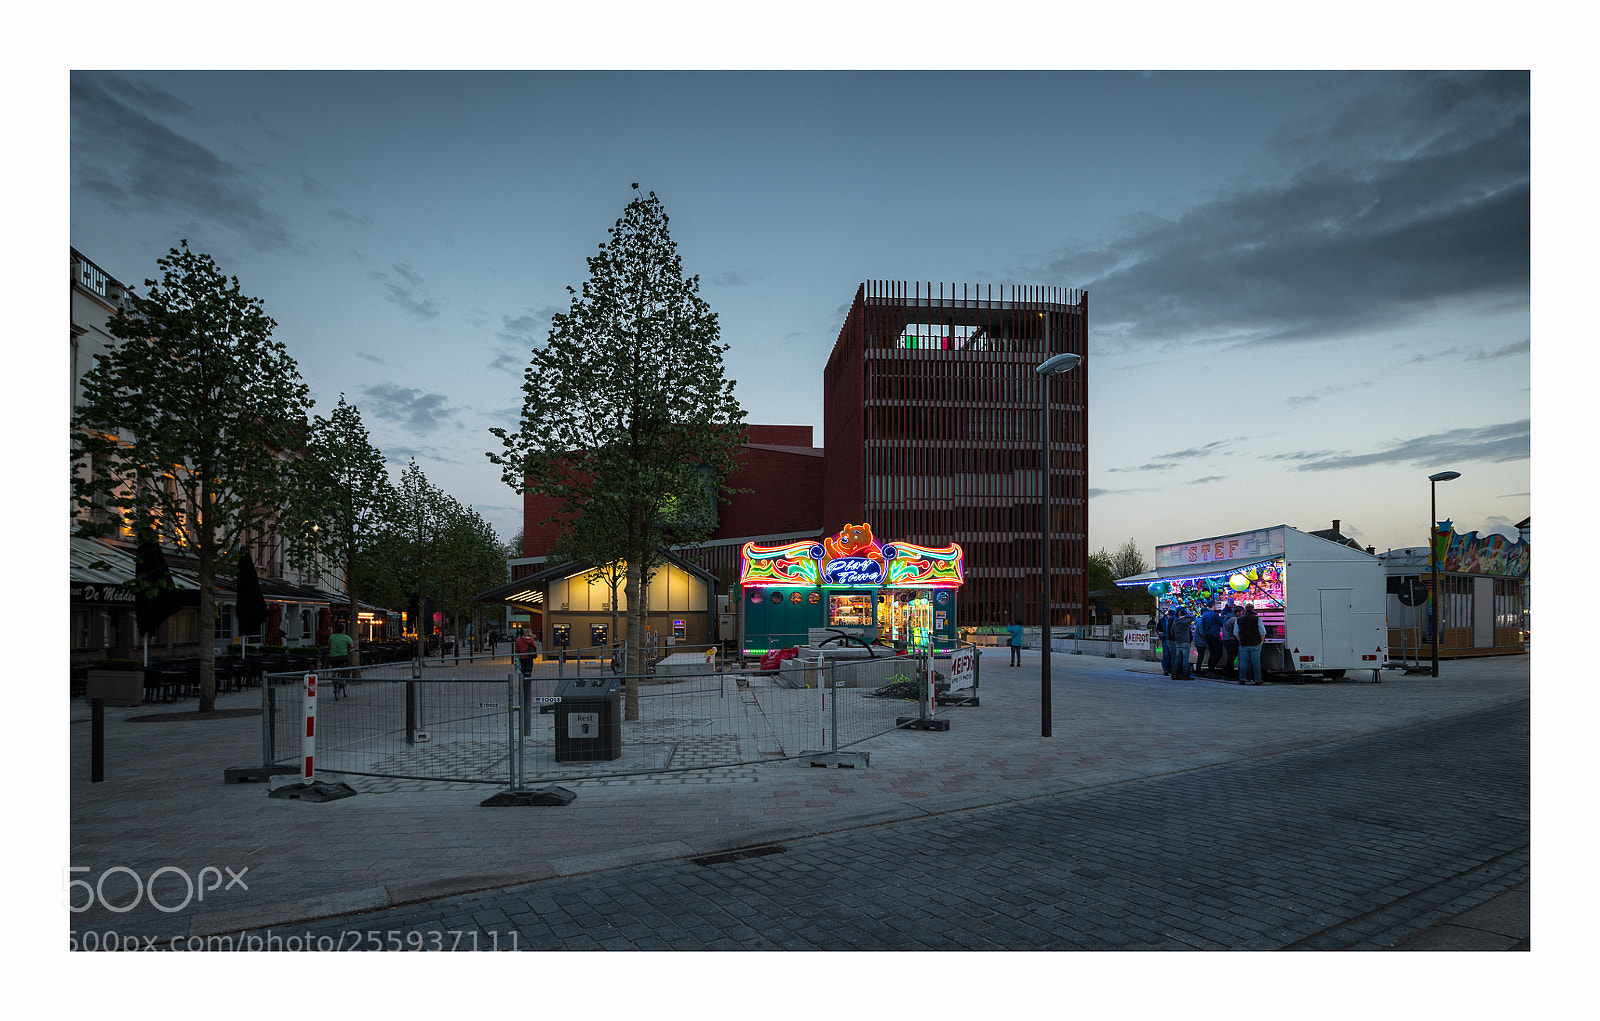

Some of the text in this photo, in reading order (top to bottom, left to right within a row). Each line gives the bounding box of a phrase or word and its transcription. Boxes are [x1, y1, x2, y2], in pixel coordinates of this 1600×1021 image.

[1188, 539, 1240, 563] STEF
[826, 559, 874, 575] Play
[837, 570, 879, 584] Time
[84, 585, 100, 601] De
[577, 714, 593, 722] Rest
